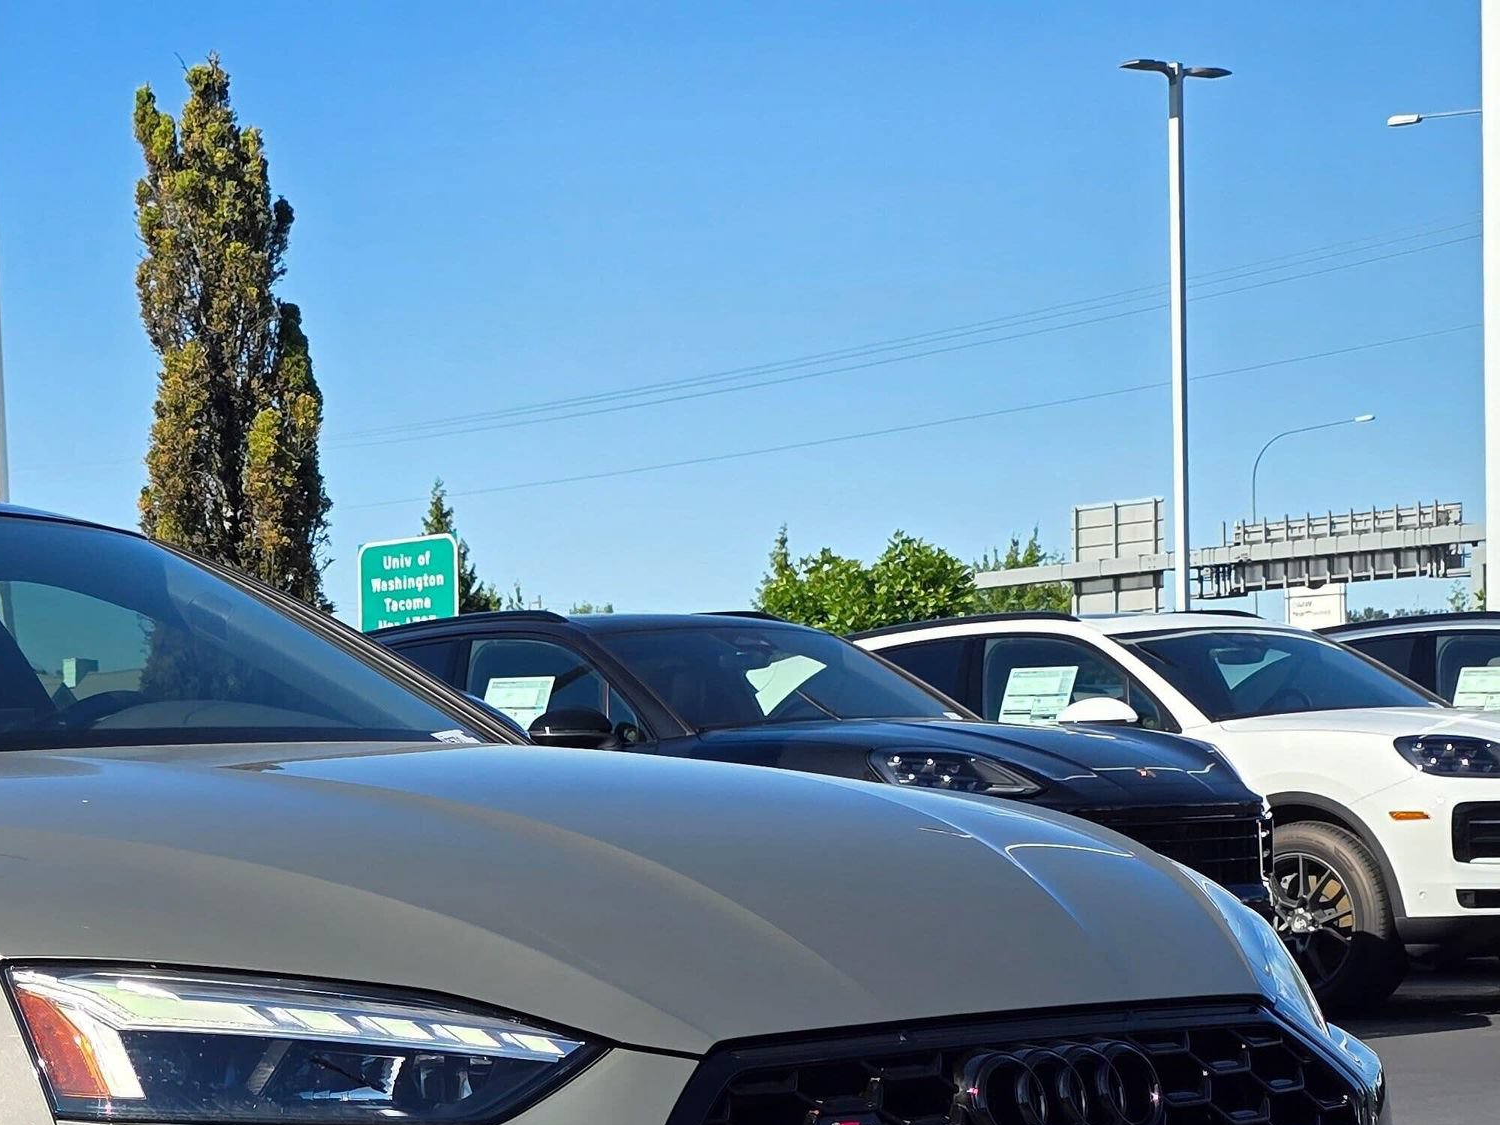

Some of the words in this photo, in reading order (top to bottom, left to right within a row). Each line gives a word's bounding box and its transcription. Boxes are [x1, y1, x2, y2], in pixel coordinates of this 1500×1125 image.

[382, 553, 412, 570] Univ
[418, 550, 431, 566] of
[371, 573, 444, 593] Washington
[383, 596, 431, 613] Tacoma
